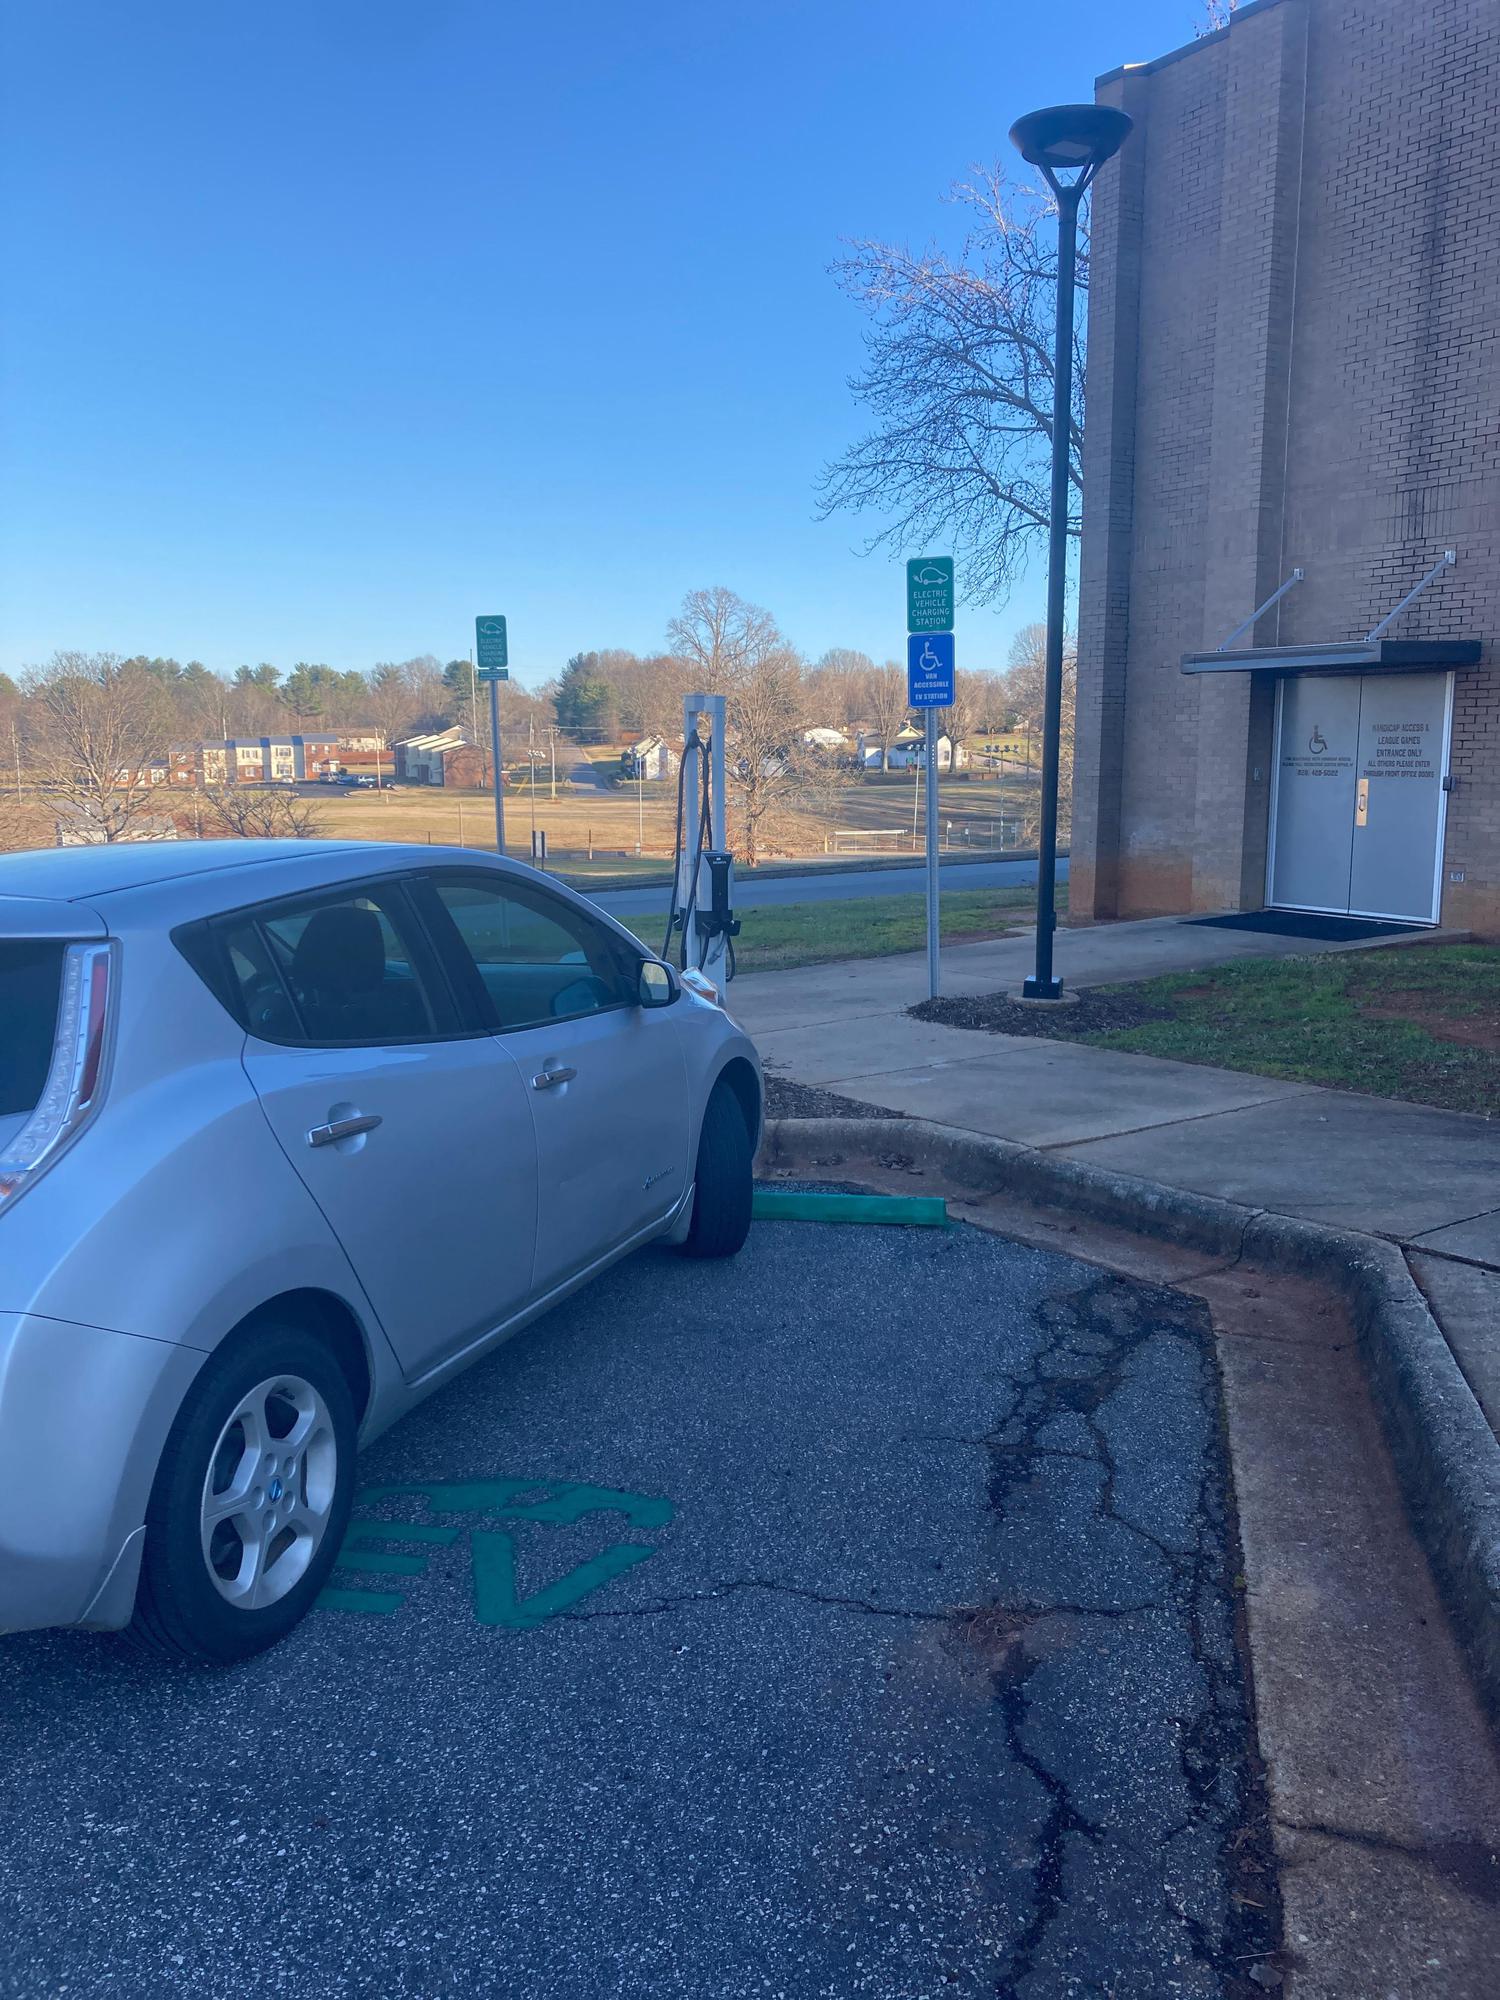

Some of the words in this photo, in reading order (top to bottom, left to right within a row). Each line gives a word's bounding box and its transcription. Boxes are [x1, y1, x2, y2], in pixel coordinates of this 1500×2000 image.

[913, 590, 948, 599] ELECTRIC
[915, 599, 946, 607] VEHICLE
[911, 608, 950, 617] CHARGING
[915, 617, 946, 626] STATION
[913, 681, 949, 689] ACCESSIBLE
[923, 692, 948, 700] STATION
[1372, 723, 1400, 732] HANDICAP
[1401, 723, 1425, 732] ACCESS
[1377, 736, 1400, 745] LEAGUE
[1400, 736, 1421, 745] GAMES
[1376, 749, 1407, 758] ENTRANCE
[1407, 749, 1423, 758] ONLY
[1396, 760, 1414, 768] PLEASE
